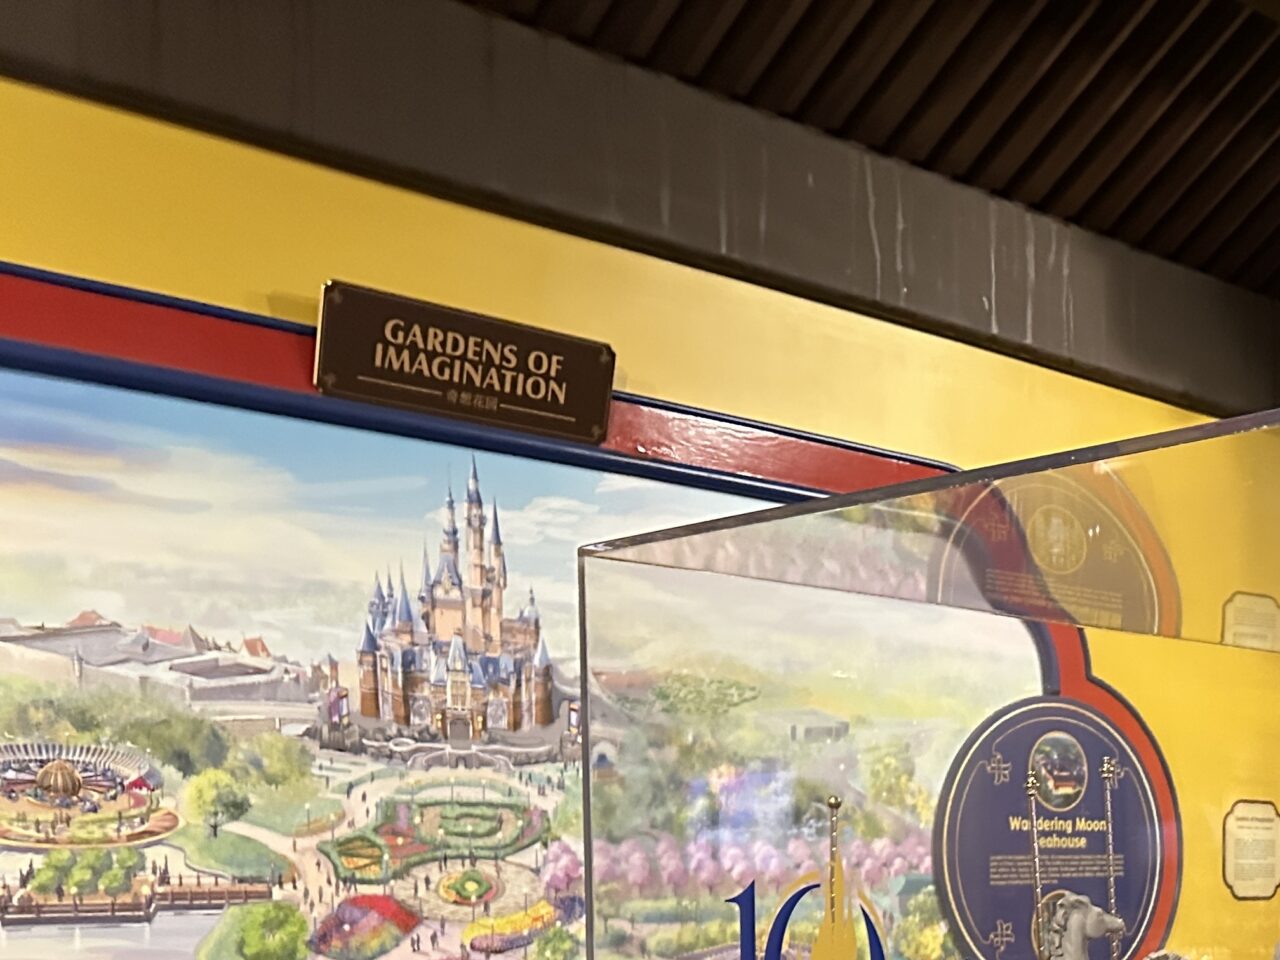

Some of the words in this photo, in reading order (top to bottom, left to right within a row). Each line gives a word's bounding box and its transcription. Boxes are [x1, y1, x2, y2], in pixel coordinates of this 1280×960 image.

[384, 318, 518, 368] GARDENS
[527, 350, 564, 378] OF
[374, 342, 567, 406] IMAGINATION
[1008, 815, 1073, 834] Wadering
[1075, 815, 1108, 831] Moon
[1035, 833, 1088, 848] eahouse
